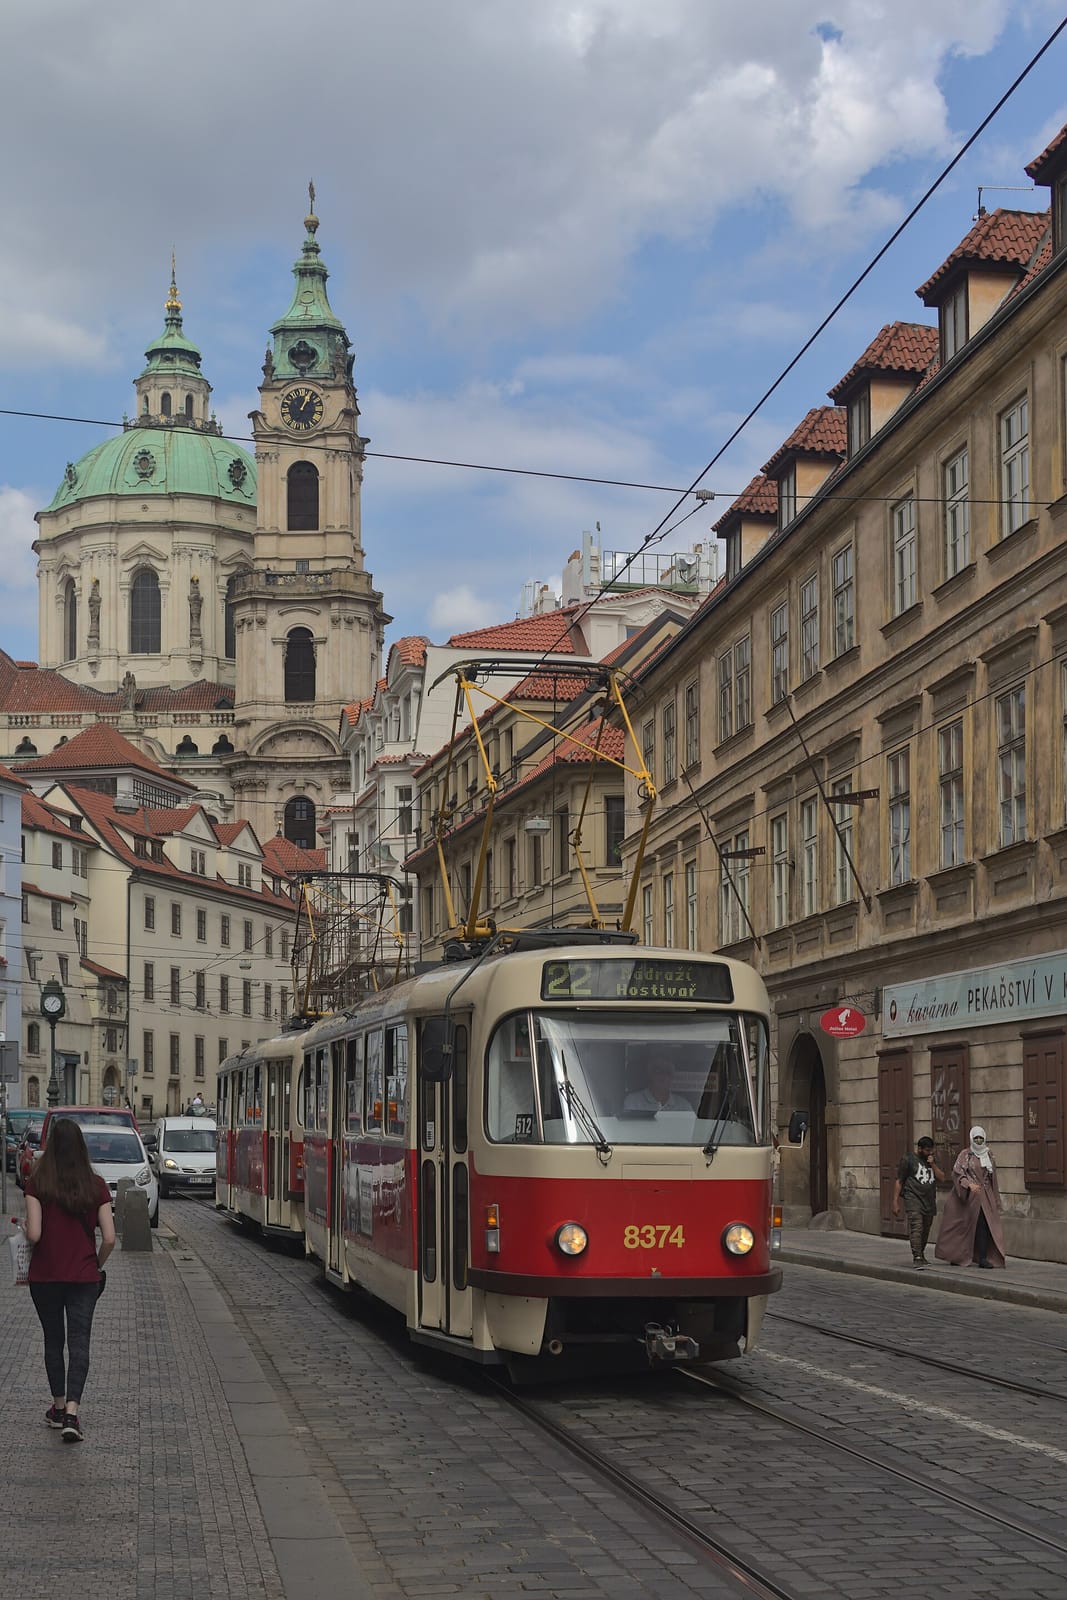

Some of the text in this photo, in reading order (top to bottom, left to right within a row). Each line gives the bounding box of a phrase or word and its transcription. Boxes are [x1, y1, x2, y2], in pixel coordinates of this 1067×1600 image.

[548, 963, 592, 995] 22
[616, 983, 697, 997] Hostivař
[906, 993, 959, 1023] kavárna
[967, 970, 1036, 1013] PEKAŘSTVÍ
[1045, 974, 1054, 1001] V
[516, 1117, 532, 1134] 512
[623, 1225, 686, 1248] 8374
